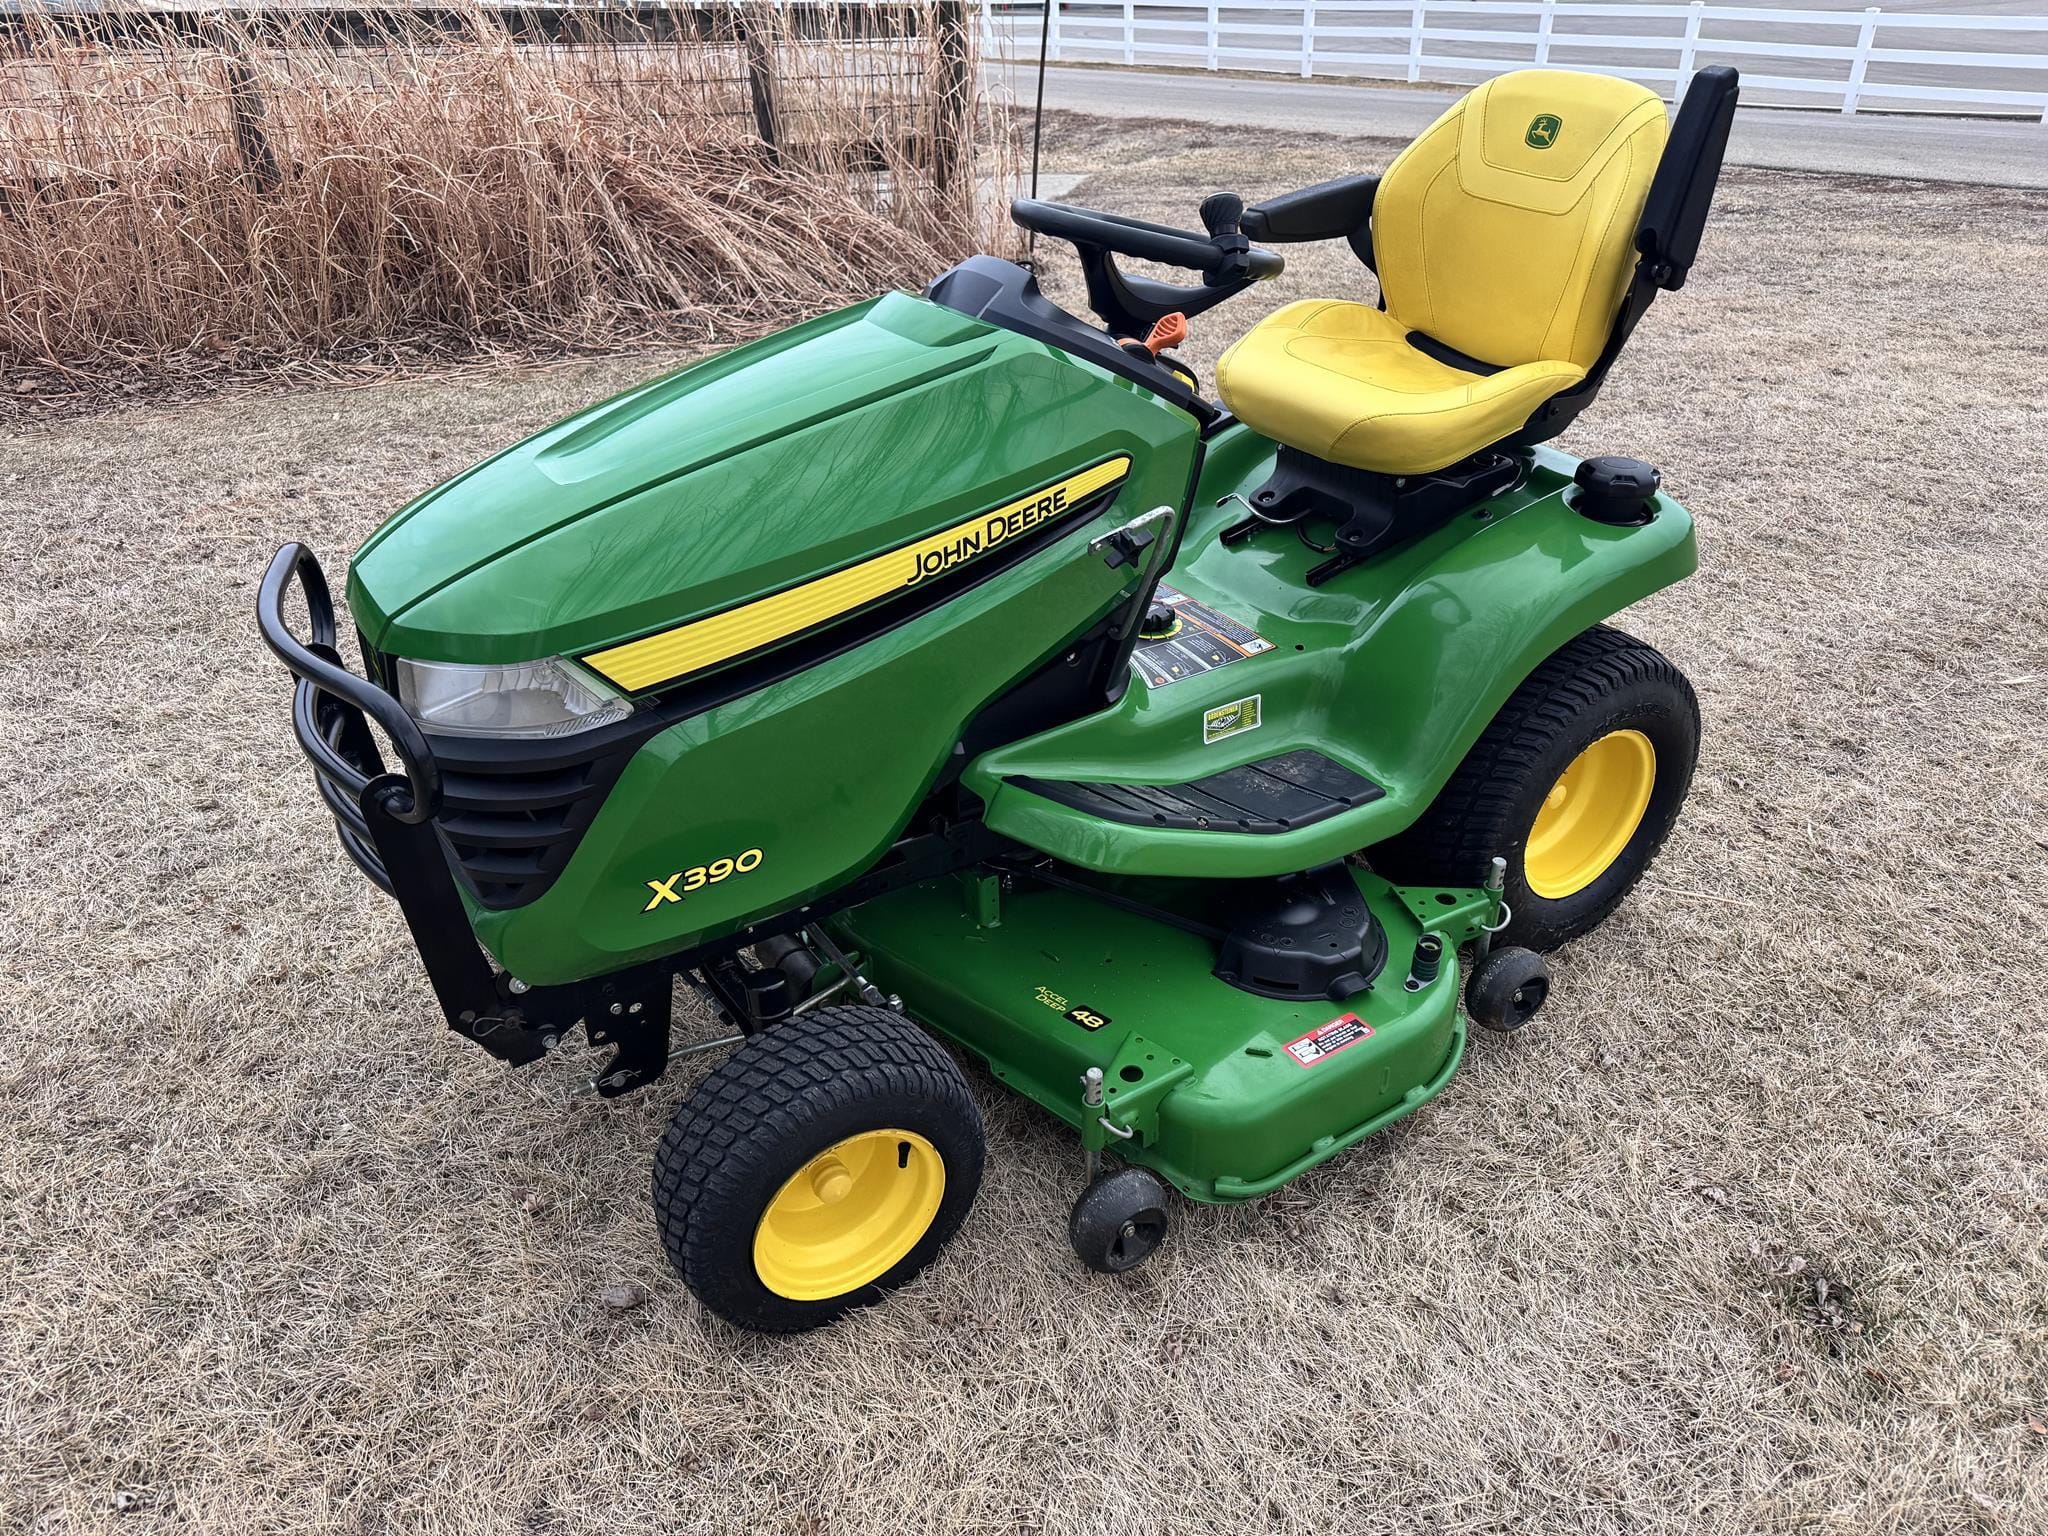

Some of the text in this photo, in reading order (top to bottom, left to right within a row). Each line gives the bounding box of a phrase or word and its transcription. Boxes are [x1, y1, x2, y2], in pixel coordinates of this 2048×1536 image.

[907, 487, 1067, 583] JOHN DEERE
[643, 847, 764, 912] X390
[1034, 986, 1068, 1006] ACCEL
[1035, 994, 1066, 1012] DEEP
[1071, 1010, 1104, 1028] 48
